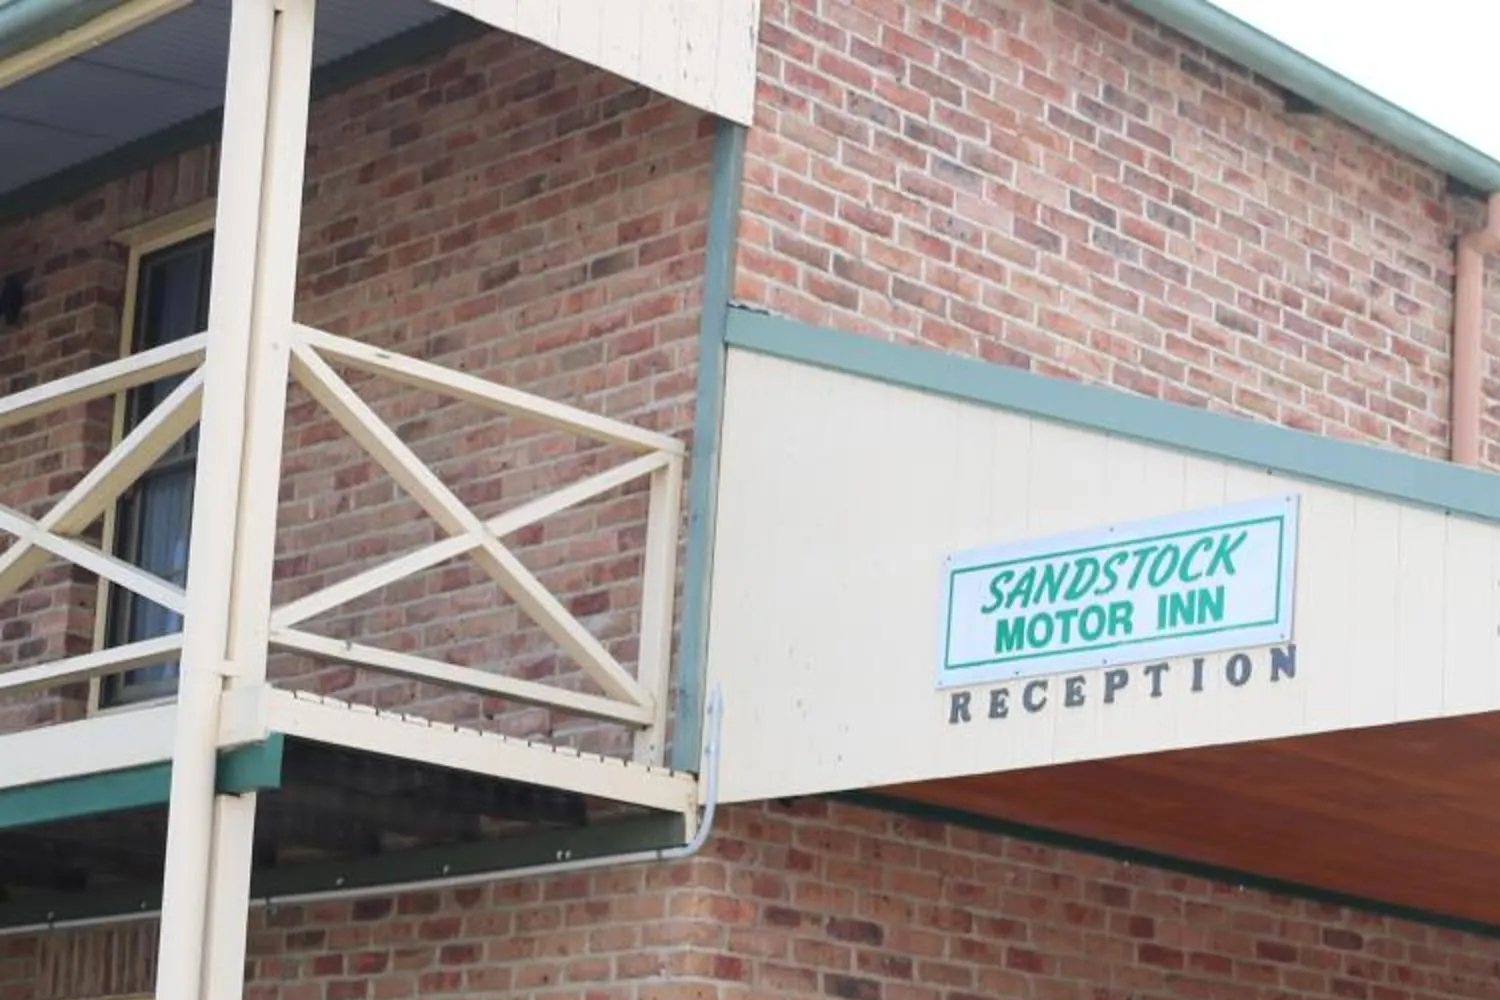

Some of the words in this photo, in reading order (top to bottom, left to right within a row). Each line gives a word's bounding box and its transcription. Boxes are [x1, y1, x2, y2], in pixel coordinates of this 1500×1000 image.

[981, 530, 1248, 614] SANDSTOCK
[994, 600, 1134, 655] MOTOR
[1157, 585, 1225, 631] INN
[948, 644, 1298, 725] RECEPTION
